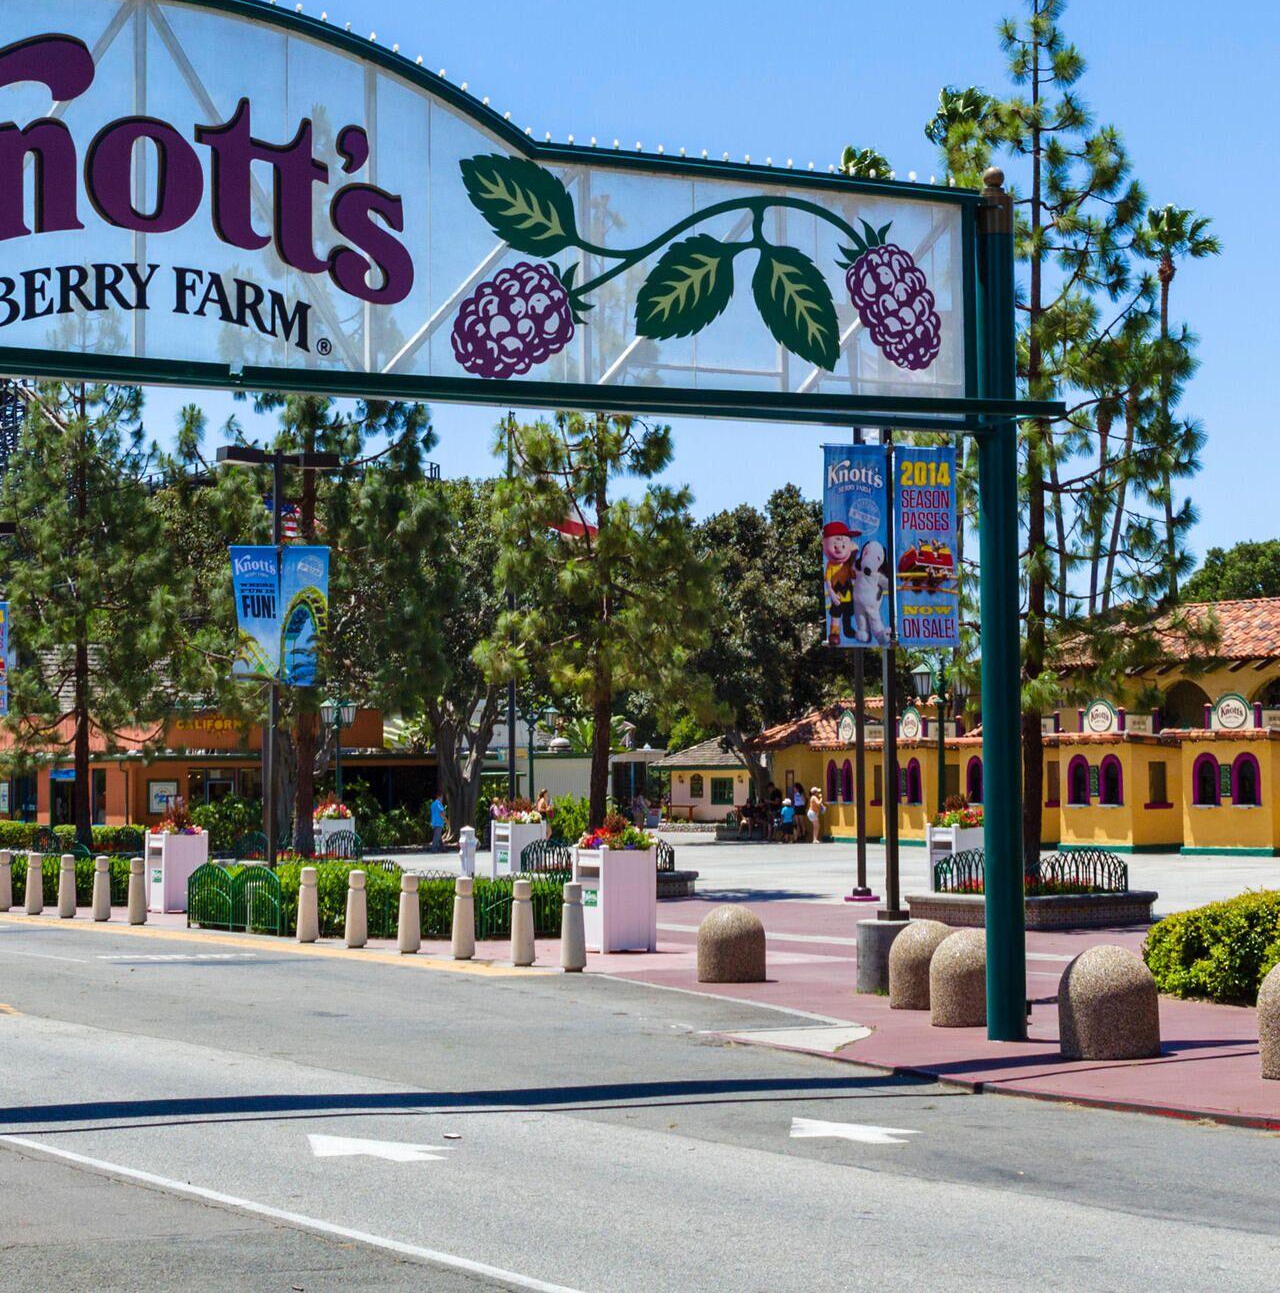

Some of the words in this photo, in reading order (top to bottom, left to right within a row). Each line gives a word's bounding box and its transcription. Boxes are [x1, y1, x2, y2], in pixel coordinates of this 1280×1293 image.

[172, 266, 311, 353] FARM
[827, 460, 883, 489] Knott's
[900, 460, 951, 487] 2014
[901, 489, 950, 509] SEASON
[901, 511, 950, 531] PASSES
[234, 554, 276, 576] Knott's
[241, 594, 277, 619] FUN!
[902, 605, 953, 615] NOW
[903, 618, 920, 638] ON
[922, 618, 955, 638] SALE!
